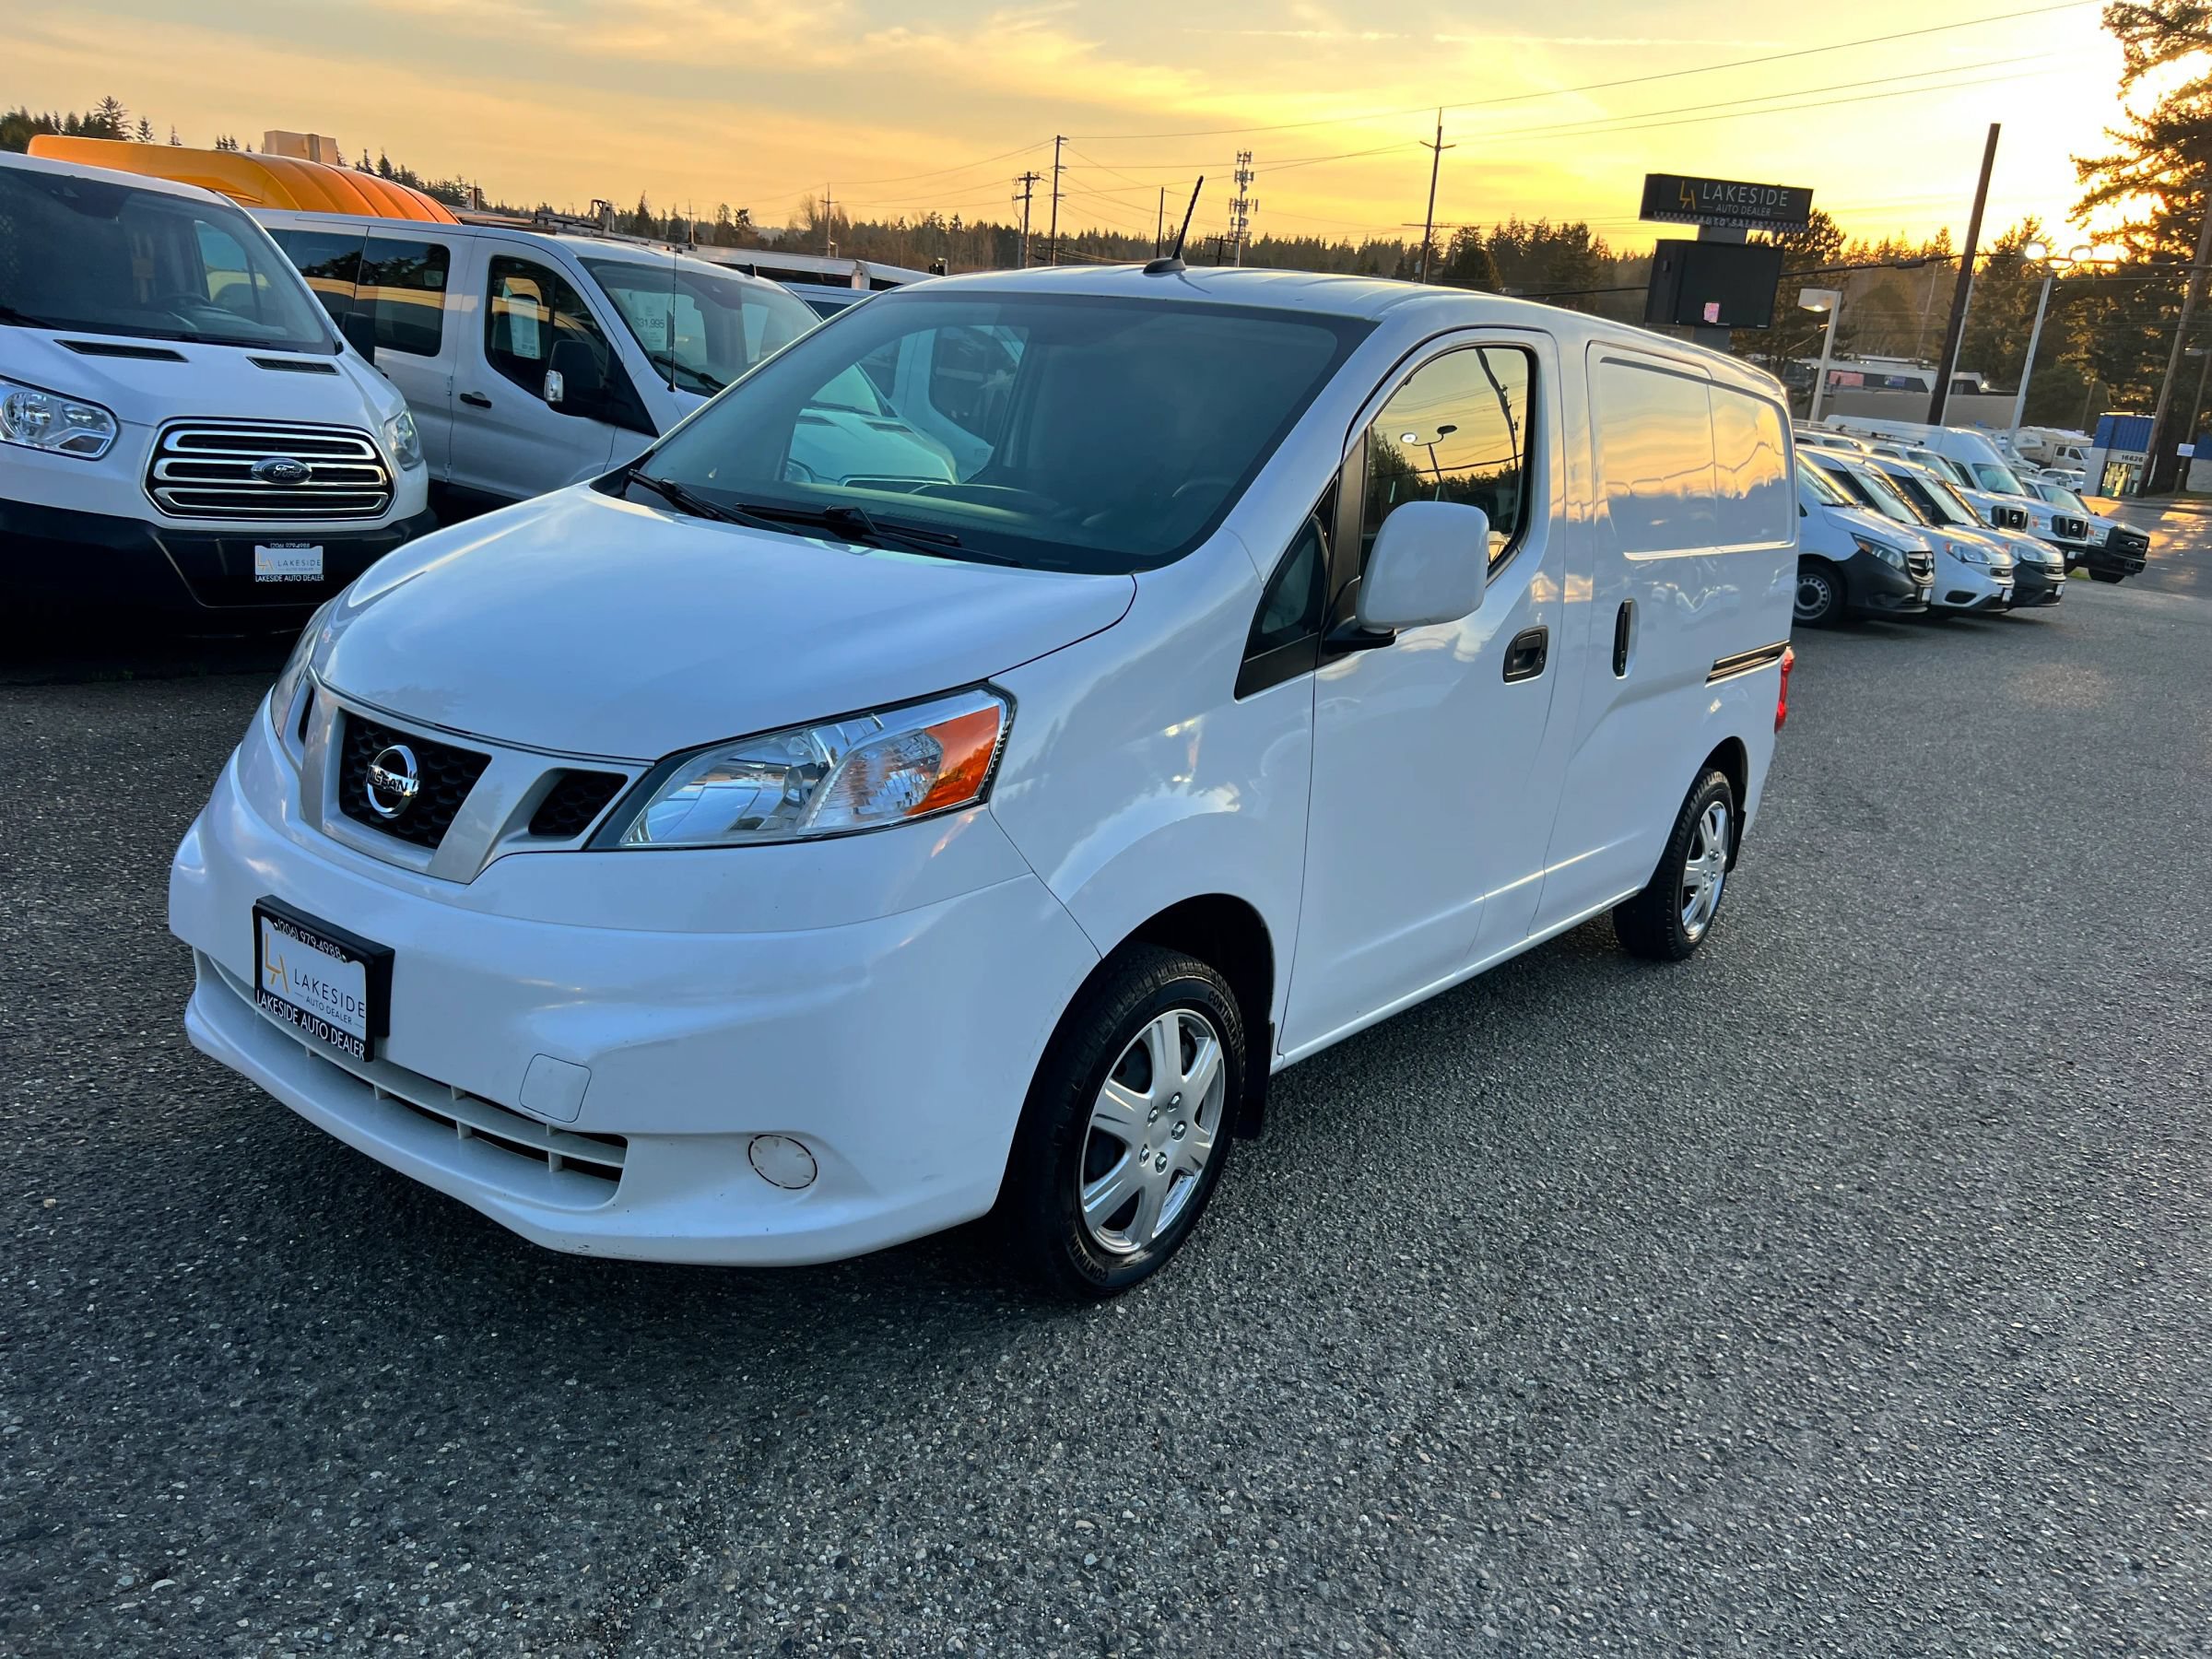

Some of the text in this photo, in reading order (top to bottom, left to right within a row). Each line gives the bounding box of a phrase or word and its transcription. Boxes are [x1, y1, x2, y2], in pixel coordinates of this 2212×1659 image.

[1702, 182, 1790, 207] LAKESIDE
[1715, 203, 1771, 218] AUTO DEALER
[273, 464, 302, 478] Ford
[2122, 454, 2144, 463] 16626
[277, 559, 322, 567] LAKESIDE
[254, 574, 324, 582] LAKESIDE AUTO DEALER
[276, 918, 342, 959] (206) 979-4988
[294, 968, 366, 1018] LAKESIDE
[306, 995, 352, 1025] AUTO DEALER
[255, 989, 365, 1061] LAKESIDE AUTO DEALER
[1207, 990, 1242, 1065] CONTINENTA
